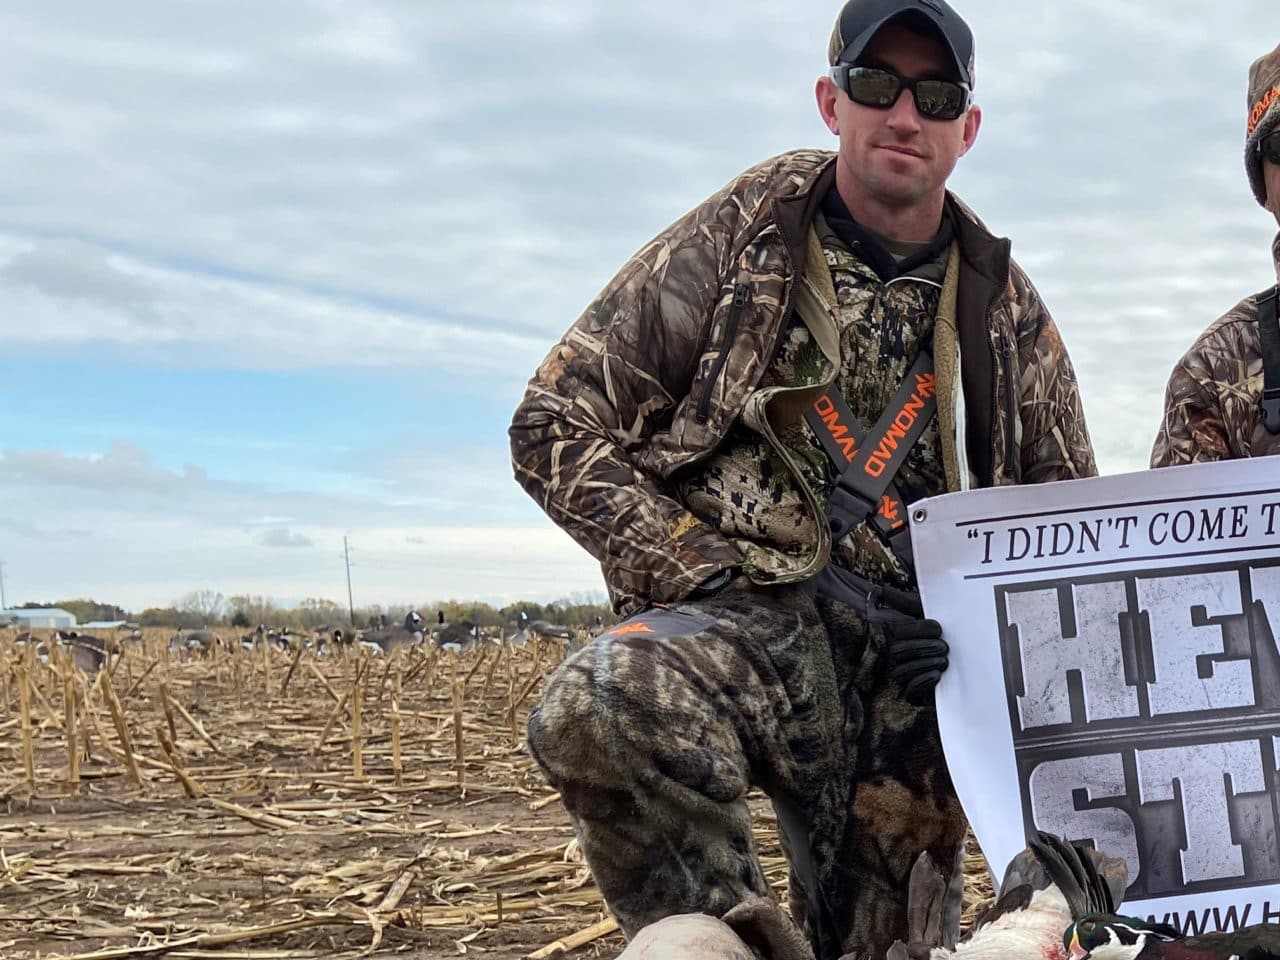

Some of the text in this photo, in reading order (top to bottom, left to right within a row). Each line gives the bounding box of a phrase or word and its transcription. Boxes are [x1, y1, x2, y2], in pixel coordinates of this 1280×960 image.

[864, 394, 925, 477] NOMAD
[1005, 516, 1138, 561] DIDN’T
[1149, 505, 1249, 546] COME
